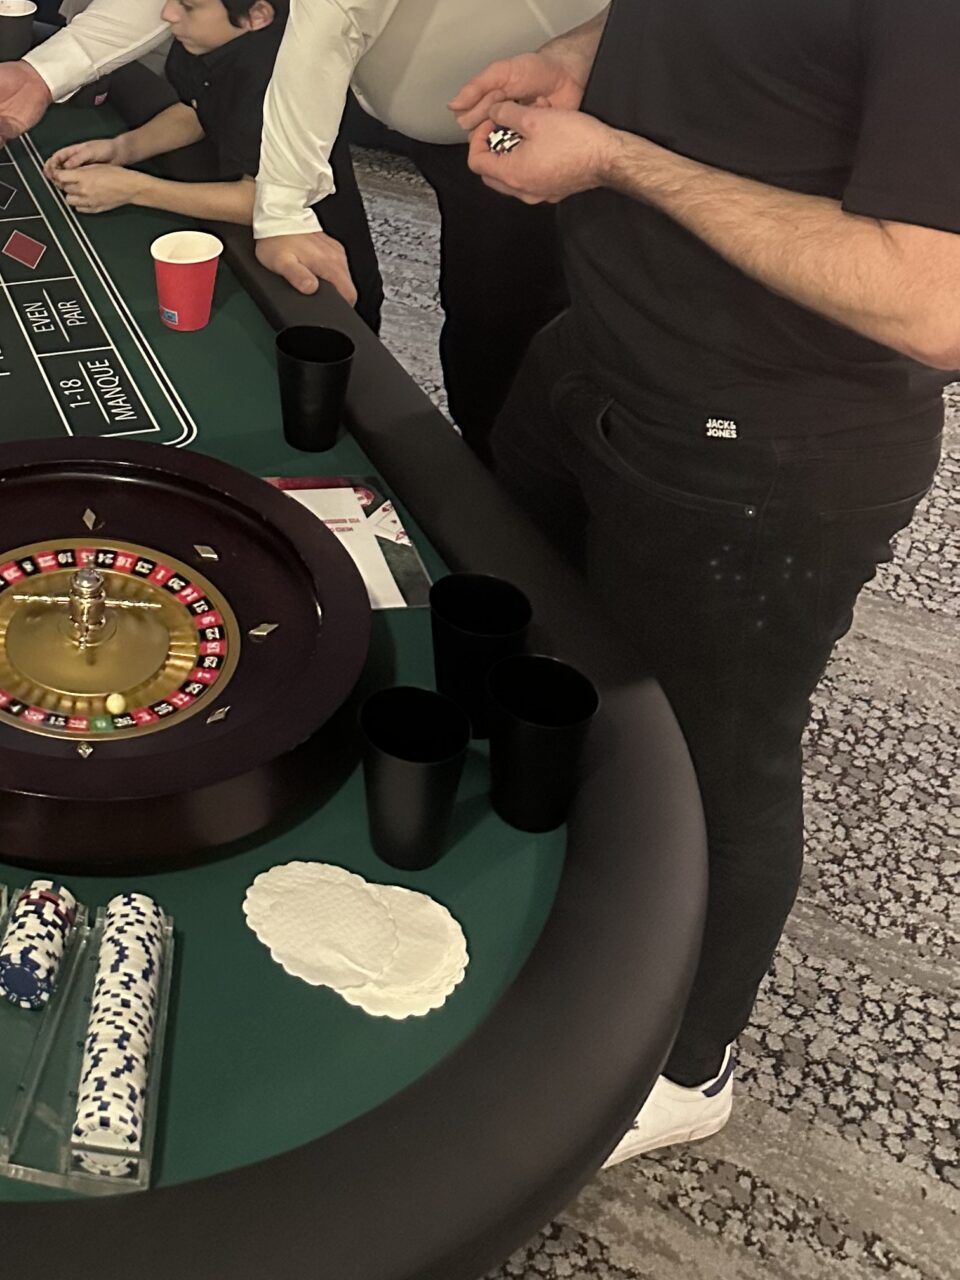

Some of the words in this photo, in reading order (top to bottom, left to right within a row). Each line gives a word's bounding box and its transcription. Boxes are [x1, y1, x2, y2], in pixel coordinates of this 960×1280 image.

[22, 301, 55, 333] EVEN
[57, 299, 88, 327] PAIR
[59, 378, 91, 409] 1-18
[86, 358, 138, 421] MANQUE
[706, 428, 738, 439] JONES
